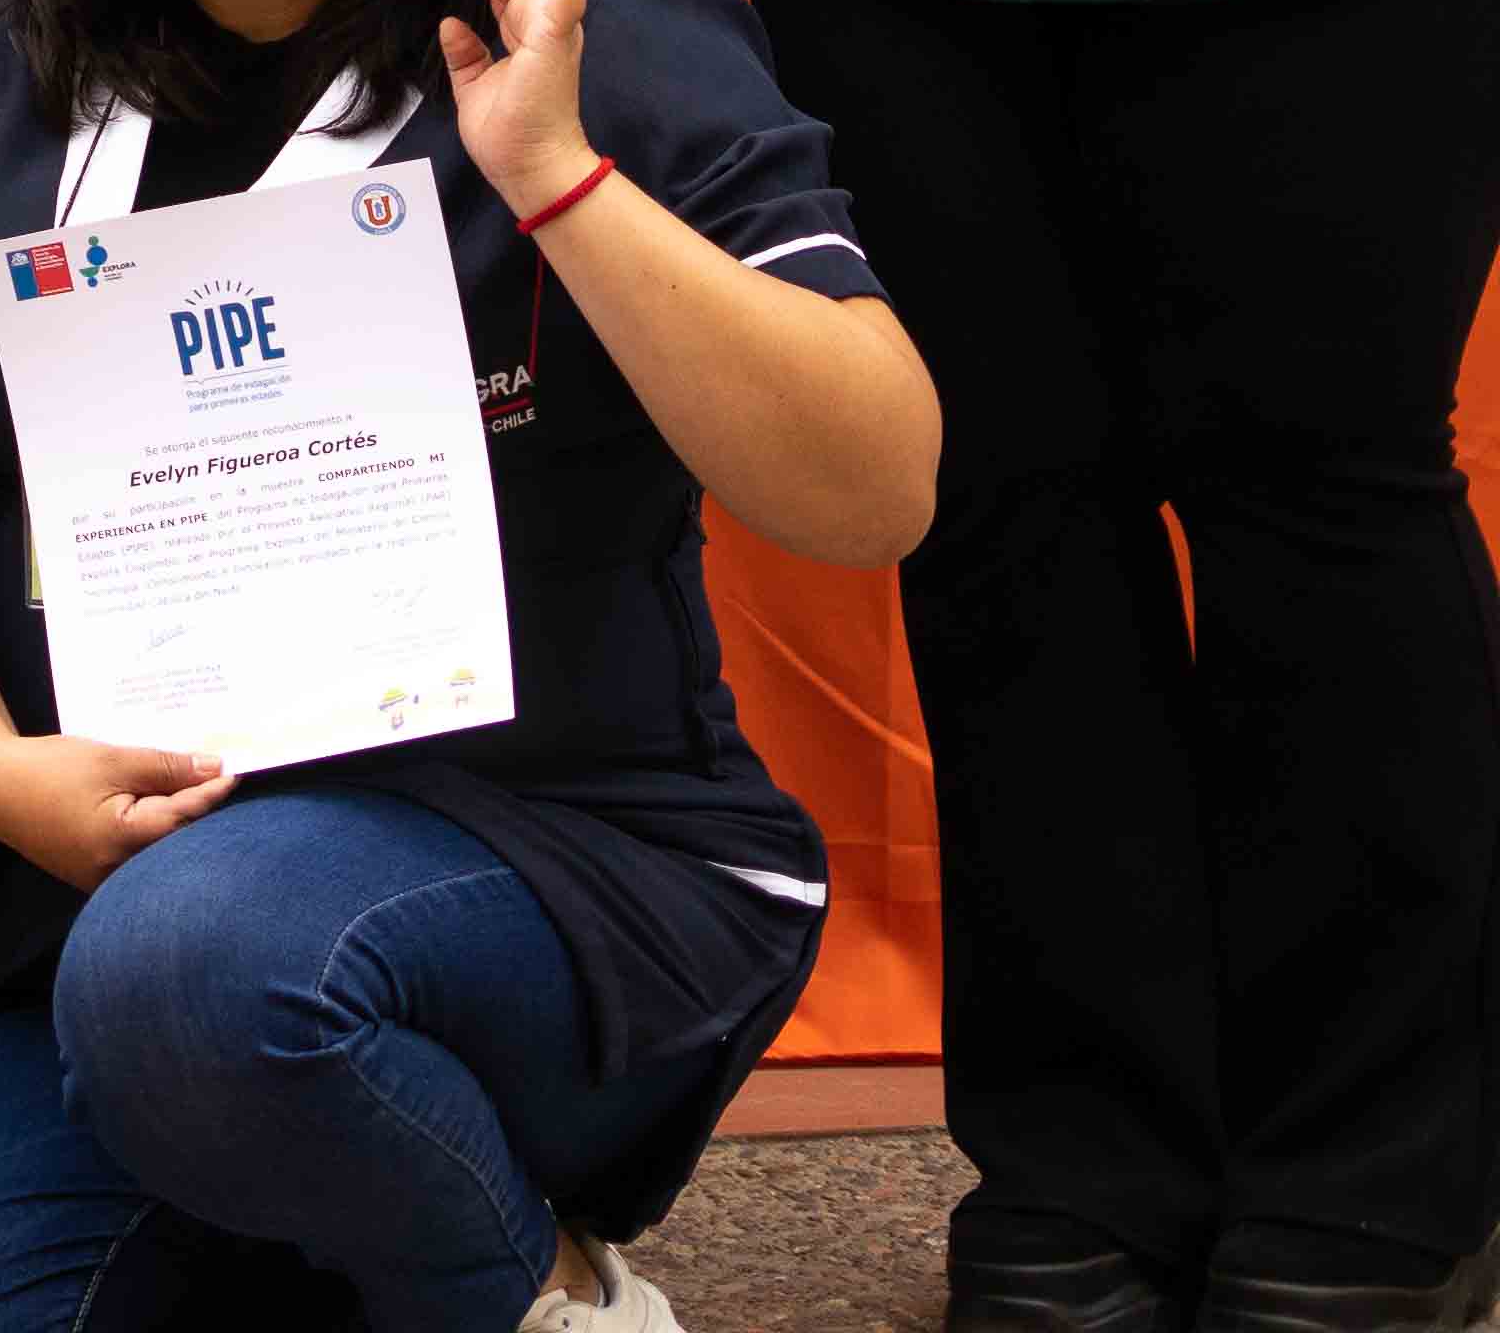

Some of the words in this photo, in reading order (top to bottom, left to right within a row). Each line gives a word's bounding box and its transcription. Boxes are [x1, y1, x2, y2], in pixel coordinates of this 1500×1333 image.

[101, 261, 136, 273] EXPLORA
[170, 295, 285, 376] PIPE
[491, 406, 537, 434] CHILE
[130, 464, 199, 487] Evelyn
[207, 447, 300, 475] Figueroa
[308, 430, 377, 456] Cortés
[318, 458, 415, 482] COMPARTIENDO
[429, 452, 444, 462] MI
[75, 521, 155, 543] EXPERIENCIA
[159, 518, 175, 529] EN
[180, 512, 207, 525] PIPE
